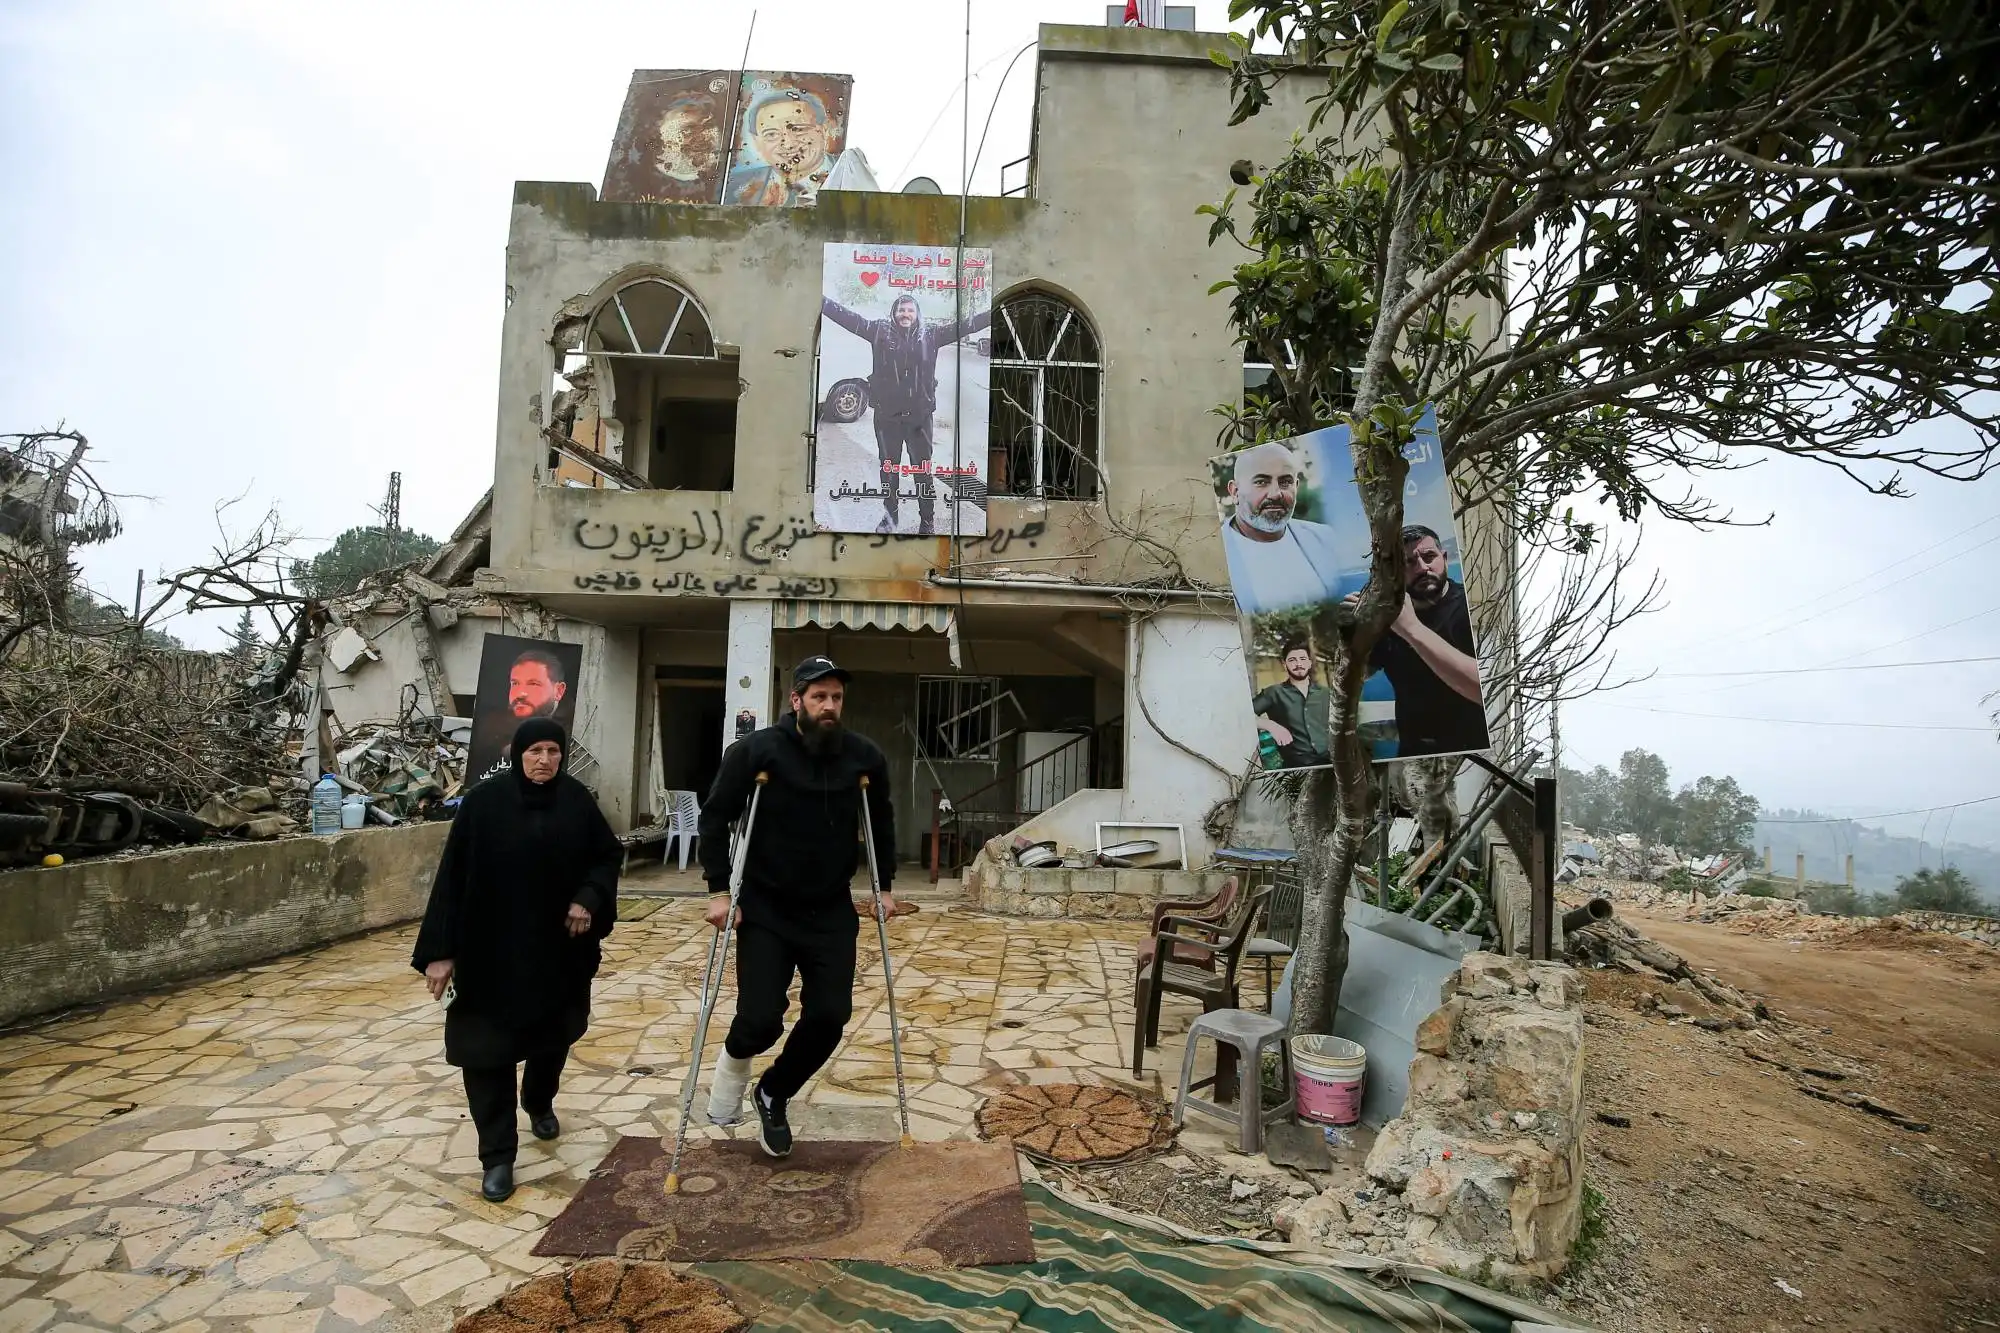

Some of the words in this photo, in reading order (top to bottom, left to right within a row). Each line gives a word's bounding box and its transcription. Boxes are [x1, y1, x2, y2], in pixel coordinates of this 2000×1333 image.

[853, 250, 888, 265] منها
[892, 251, 933, 269] خرجنا
[938, 254, 952, 267] ما
[960, 257, 987, 271] نح
[926, 275, 969, 292] لعود
[881, 459, 933, 477] العودة
[935, 460, 978, 478] شيد
[896, 482, 937, 504] غالب
[713, 574, 757, 594] علي
